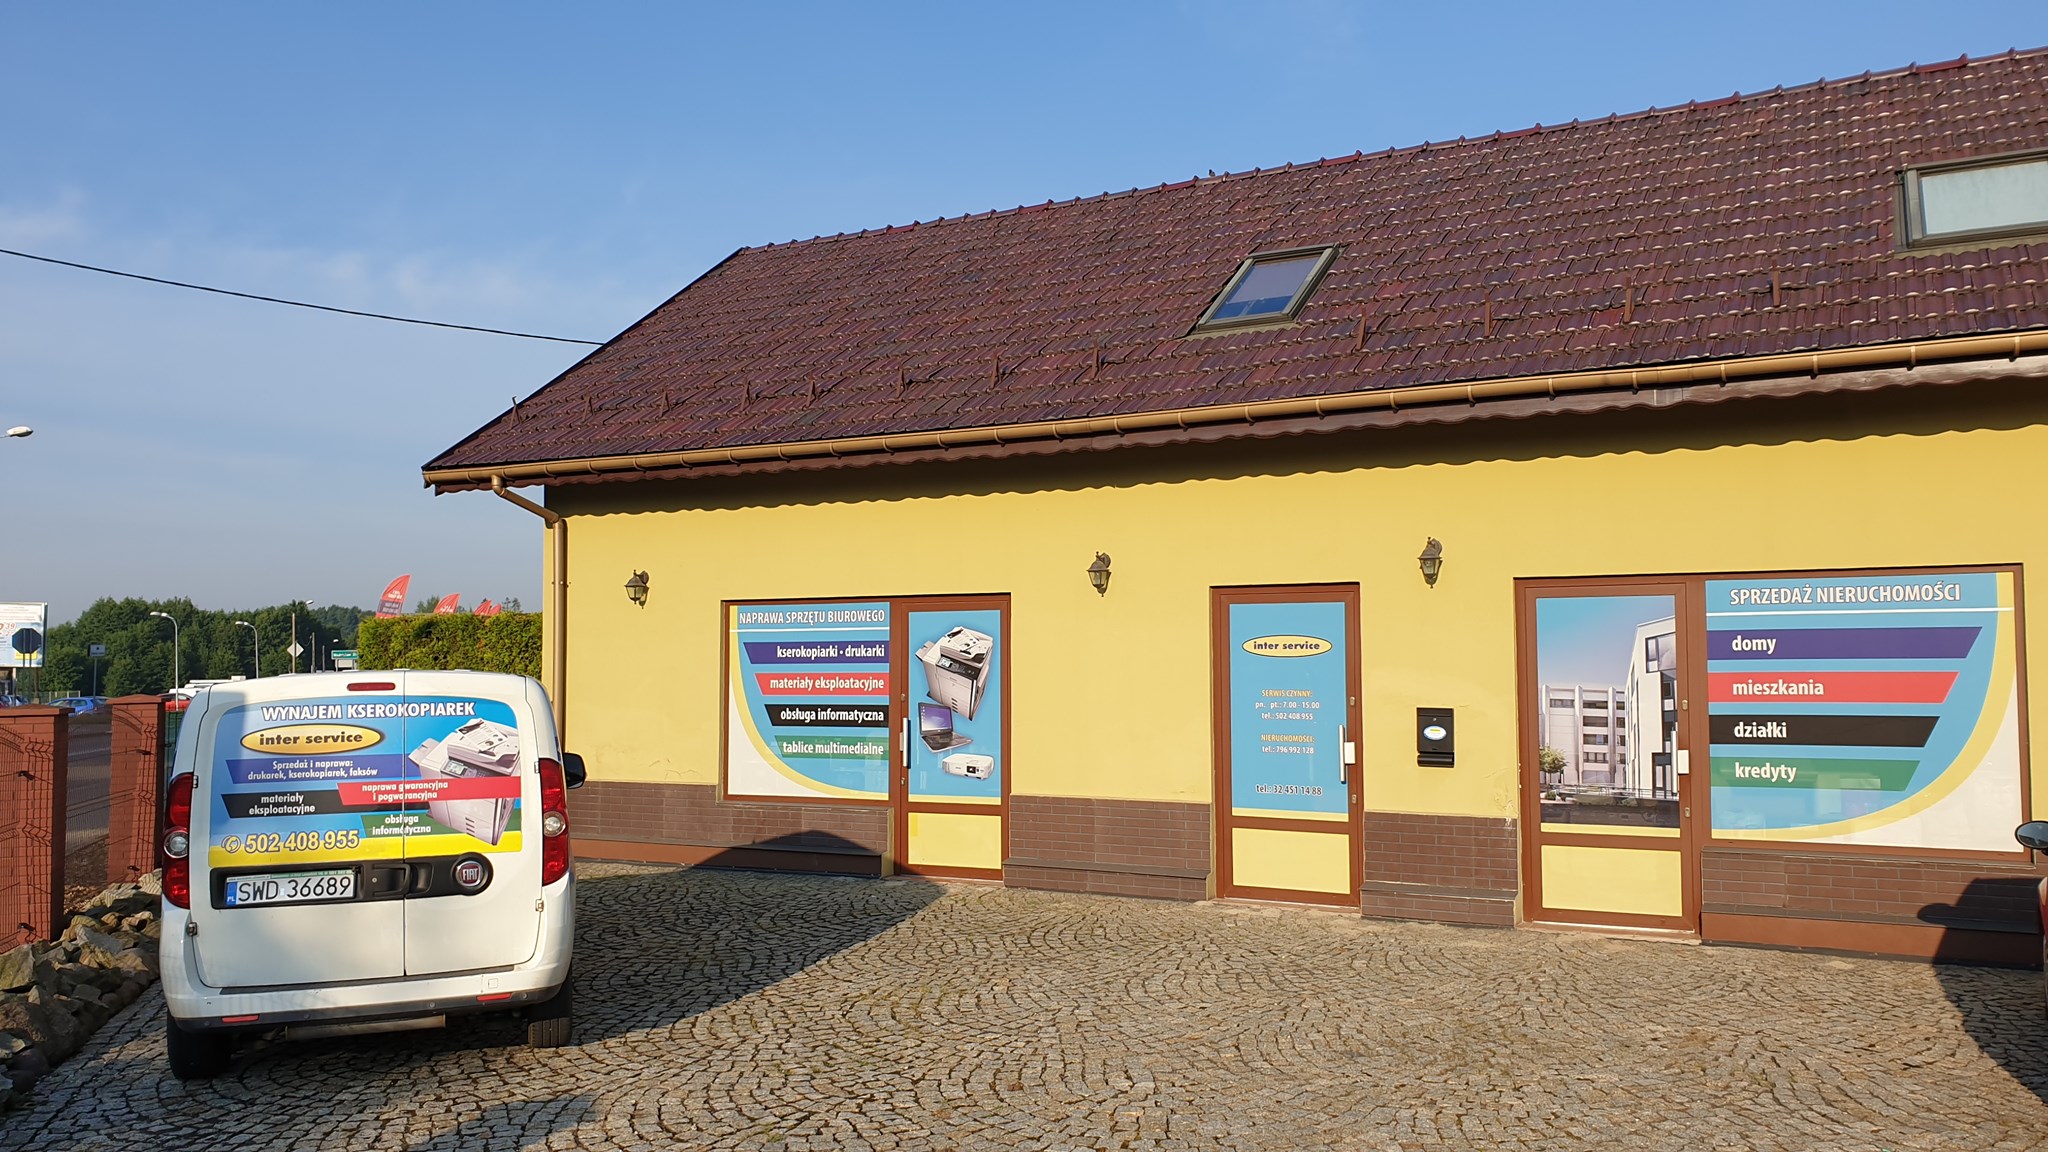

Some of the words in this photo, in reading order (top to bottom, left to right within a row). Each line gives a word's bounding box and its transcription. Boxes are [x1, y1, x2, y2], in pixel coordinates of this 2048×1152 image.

[1729, 584, 1813, 606] SPRZEDAŻ
[1816, 580, 1961, 603] NIERUCHOMOŚCI
[739, 611, 784, 625] NAPRAWA
[786, 610, 825, 626] SPRZĘTU
[827, 609, 885, 623] BIUROWEGO
[777, 645, 838, 660] kserokopiarki
[845, 644, 885, 658] drukarki
[1253, 640, 1279, 650] inter
[1282, 640, 1320, 650] service
[1731, 635, 1776, 655] domy
[770, 676, 813, 692] materiały
[815, 676, 884, 692] eksploatacyjne
[1732, 678, 1824, 696] mieszkania
[1261, 689, 1285, 697] SERWIS
[1286, 690, 1313, 698] CZYNNY:
[261, 705, 344, 722] WYNAJEM
[347, 702, 476, 720] KSEROKOPIAREK
[780, 708, 816, 723] obsługa
[817, 707, 884, 723] informatyczna
[1275, 712, 1287, 720] 502
[1734, 722, 1787, 738] działki
[259, 733, 302, 746] inter
[305, 731, 363, 745] service
[1261, 734, 1315, 743] NIERUCHOMOŚCI:
[783, 741, 814, 755] tablice
[815, 741, 884, 755] multimedialne
[272, 760, 308, 771] Sprzedaż
[315, 760, 353, 769] naprawa:
[1735, 762, 1797, 783] kredyty
[248, 770, 287, 780] drukarek,
[288, 768, 348, 779] kserokopiarek,
[349, 767, 378, 777] faksów
[362, 783, 397, 793] naprawa
[398, 781, 448, 793] gwarancyjna
[1273, 784, 1283, 794] 32
[1284, 785, 1299, 795] 451
[1301, 785, 1310, 795] 14
[1311, 785, 1322, 795] 88
[260, 792, 304, 805] materiały
[378, 791, 437, 802] pogwarancyjna
[249, 805, 315, 816] eksploatacyjne
[385, 814, 418, 825] obsługa
[372, 825, 431, 836] informatyczna
[244, 834, 281, 854] 502
[283, 831, 320, 852] 408
[324, 829, 359, 850] 955
[462, 869, 480, 883] FIAT
[238, 880, 279, 902] SWD
[286, 876, 351, 898] 36689
